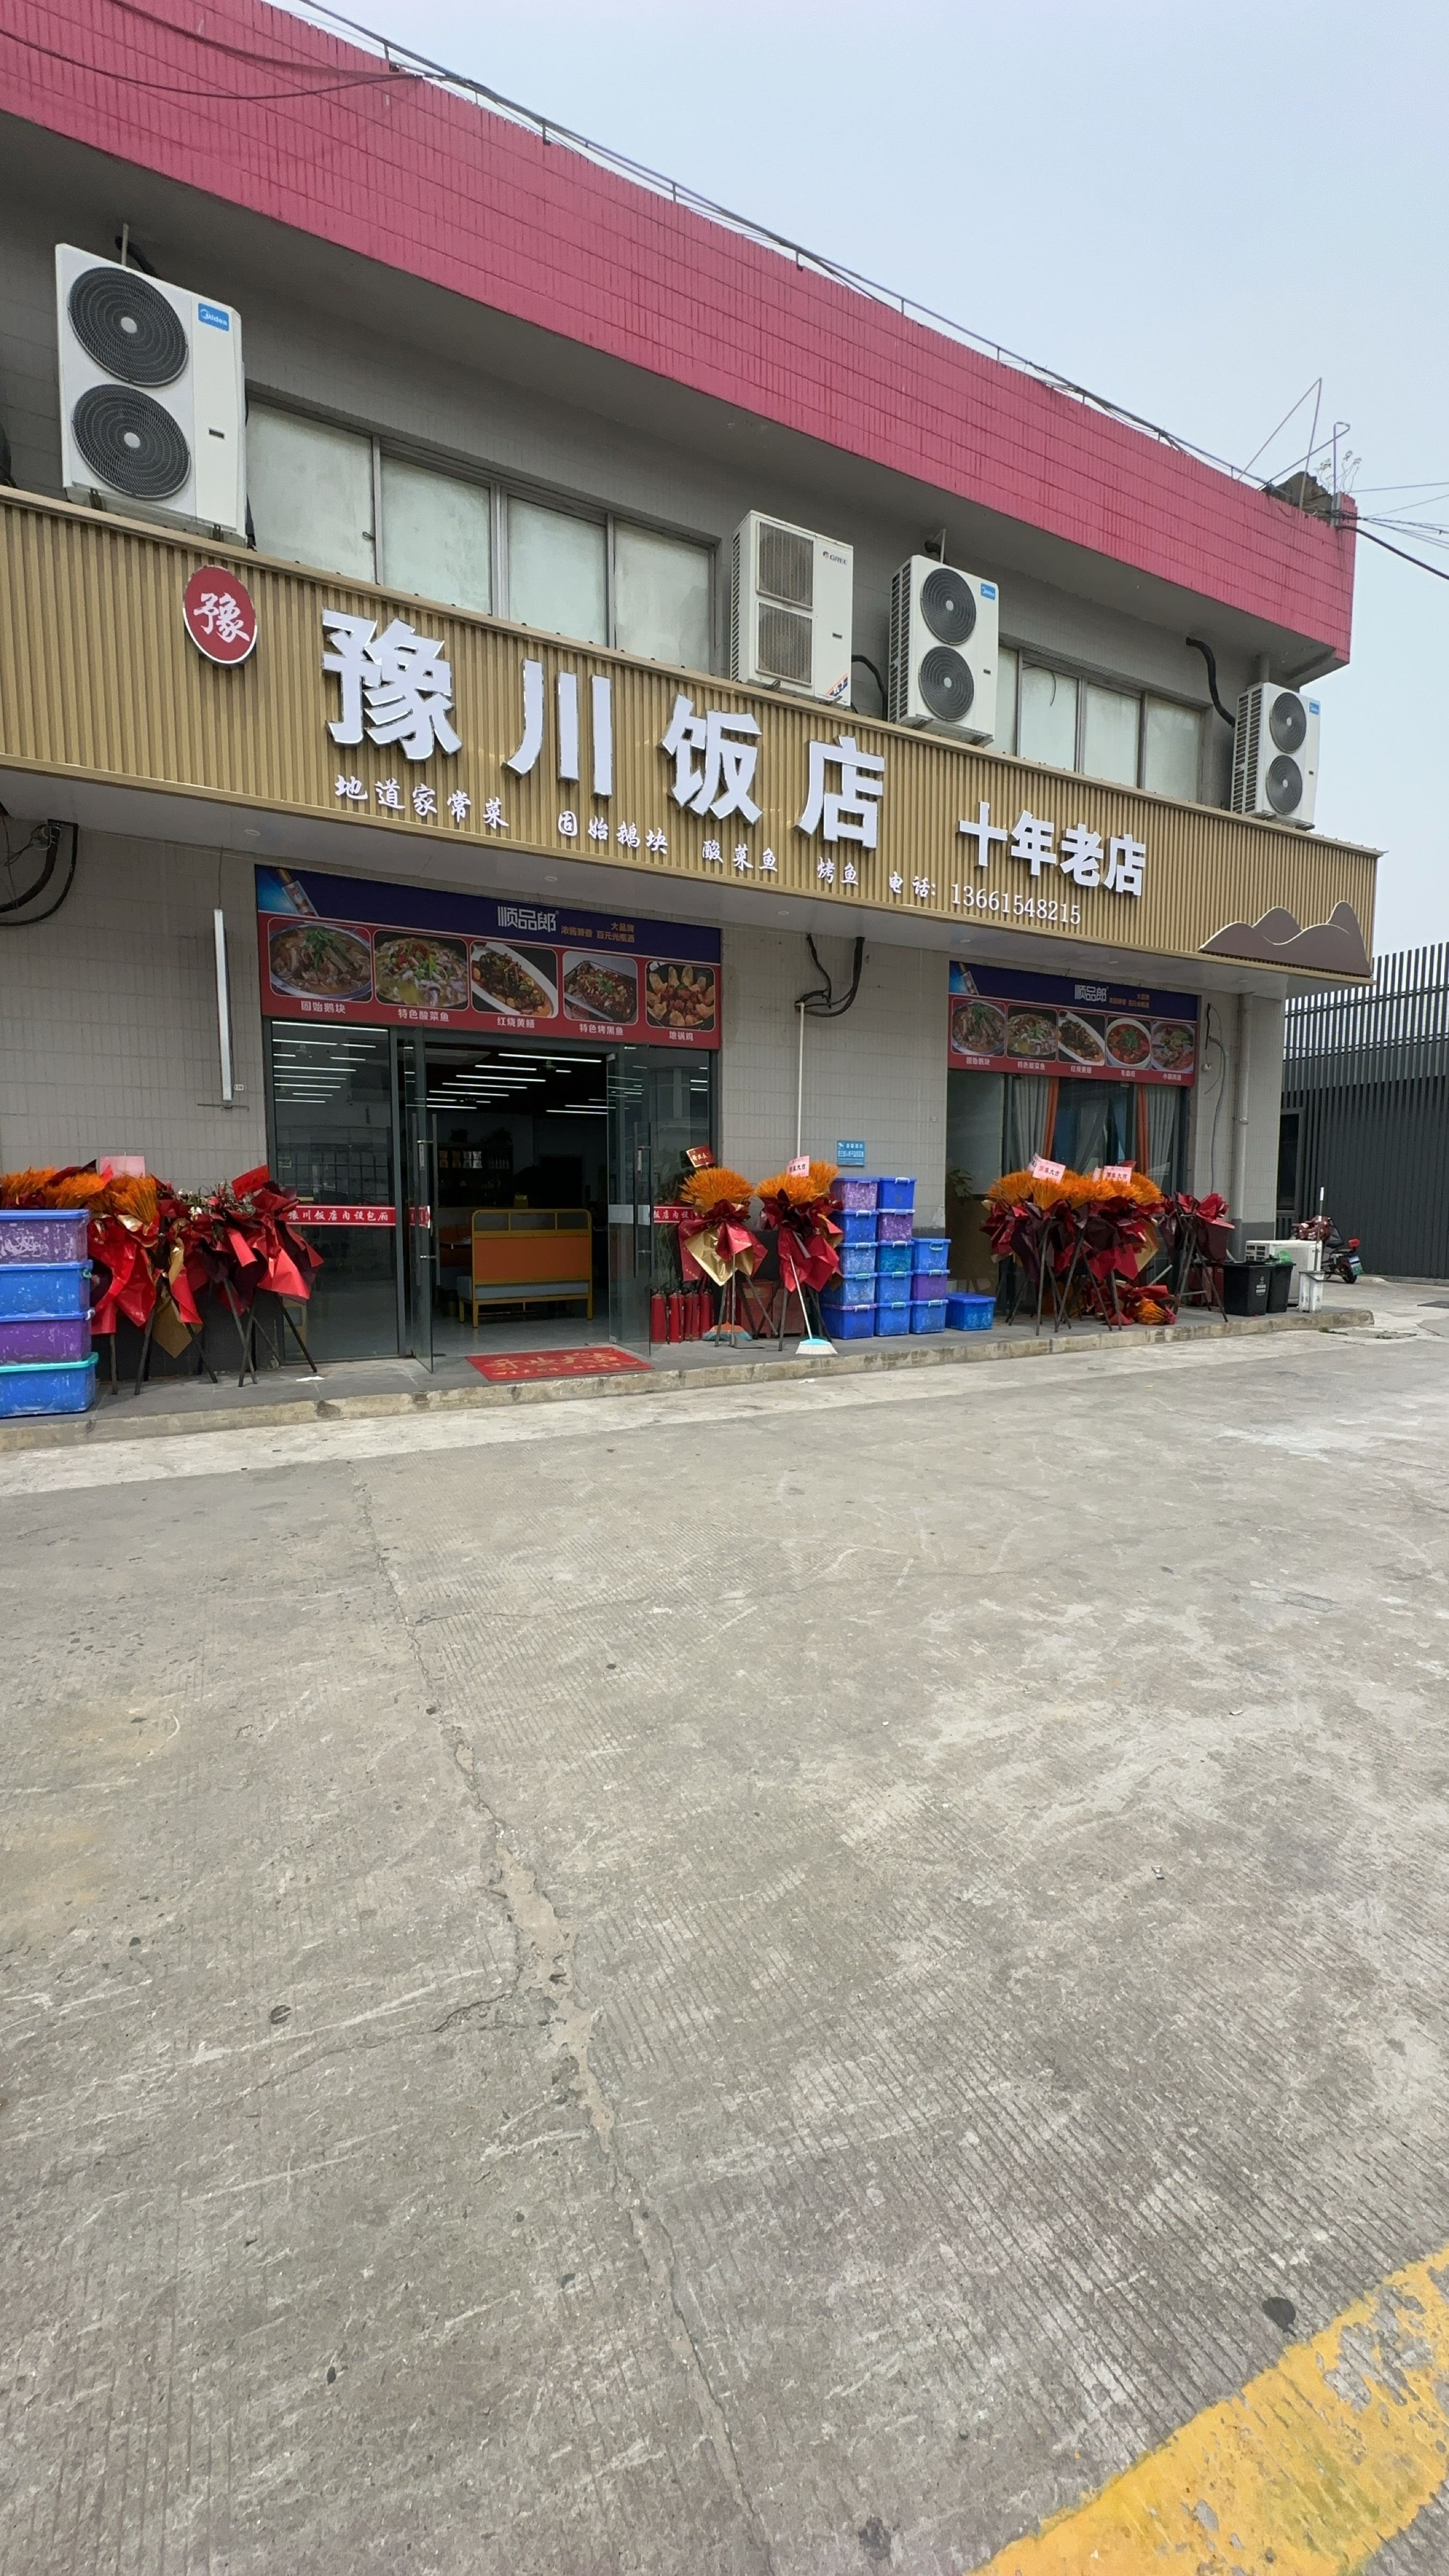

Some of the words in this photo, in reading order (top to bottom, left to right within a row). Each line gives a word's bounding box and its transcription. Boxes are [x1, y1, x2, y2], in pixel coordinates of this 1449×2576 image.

[193, 592, 251, 643] 豫
[322, 609, 885, 850] 豫川饭店
[335, 775, 509, 829] 地道家常菜
[558, 810, 668, 854] 固始鹅块
[702, 839, 778, 872] 酸菜鱼
[817, 857, 859, 885] 烤鱼
[952, 883, 1081, 925] 13661548215
[958, 801, 1146, 897] 十年老店
[497, 906, 557, 932] 顺品郎
[301, 1001, 346, 1015] 固始鹅块
[398, 1008, 449, 1023] 特色酸菜鱼
[669, 1030, 694, 1042] 地锅鸡
